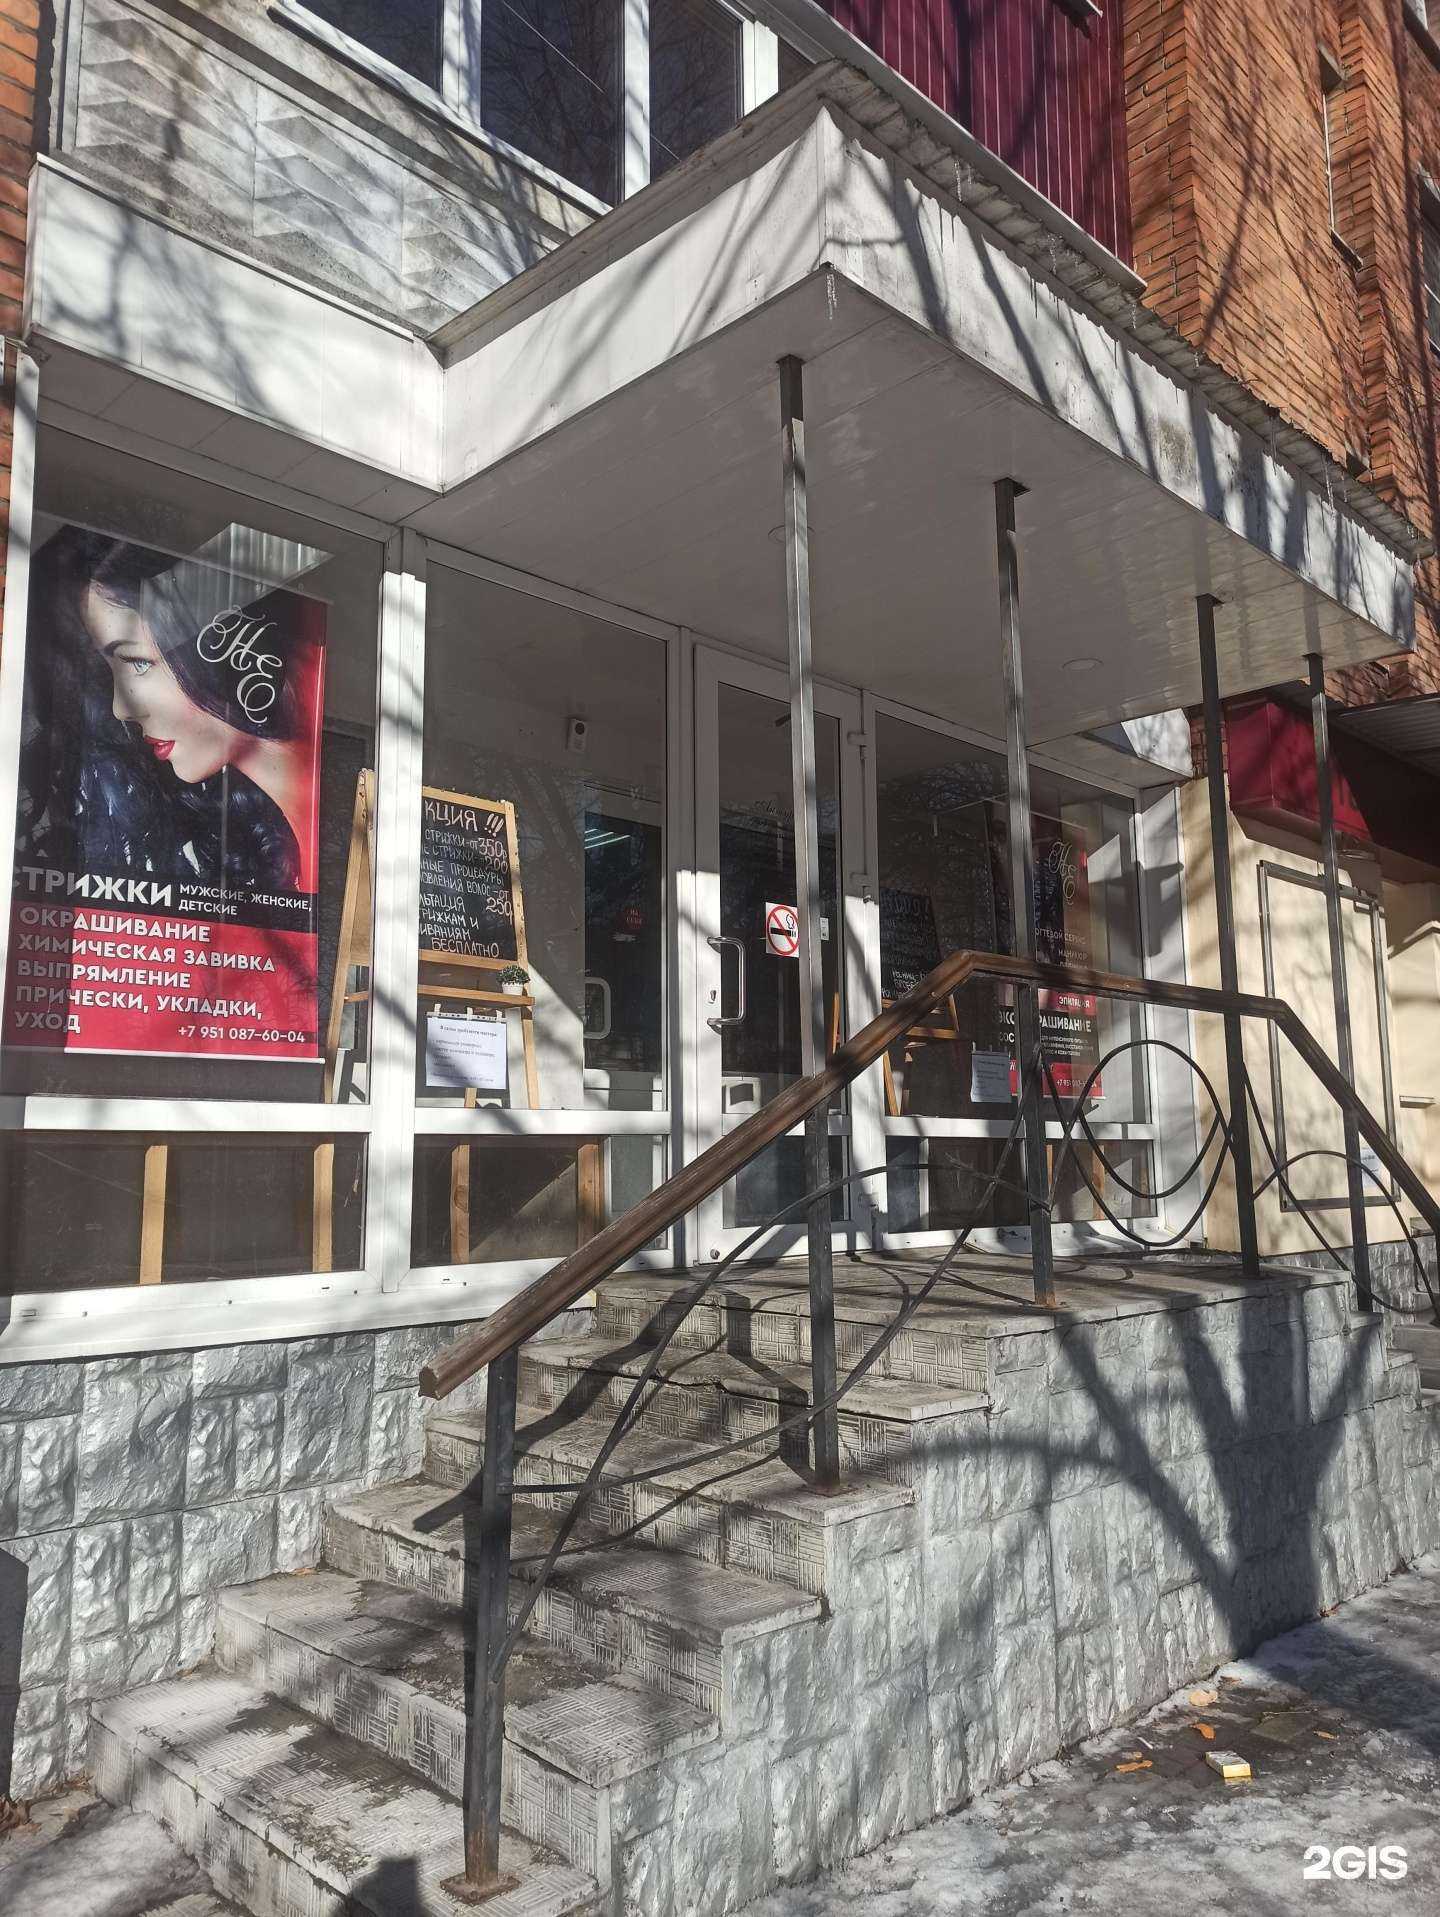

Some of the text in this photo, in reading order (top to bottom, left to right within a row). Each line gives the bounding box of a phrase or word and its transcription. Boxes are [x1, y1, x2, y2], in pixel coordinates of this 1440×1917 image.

[425, 800, 478, 832] КЦИЯ
[420, 859, 444, 873] НЫЕ
[178, 899, 238, 916] ДЕТСКИЕ
[180, 883, 247, 904] МУЖСКИЕ,
[251, 893, 312, 912] ЖЕНСКИЕ,
[420, 893, 466, 913] ЛЬТАЦИЯ
[19, 906, 211, 943] ОКРАШИВАНИЕ
[421, 908, 466, 927] РИЖКАМ
[420, 923, 471, 941] ИВАНИЯМ
[18, 934, 276, 972] ХИМИЧЕСКАЯ ЗАВИВКА
[432, 937, 500, 958] БЕСПЛАТНО
[17, 960, 191, 988] ВЫПРЯМЛЕНИЕ
[16, 985, 262, 1020] ПРИЧЕСКИ, УКЛАДКИ,
[14, 1011, 81, 1034] УХОД
[1039, 1015, 1092, 1033] РАШИВАНИЕ
[178, 1025, 305, 1043] +7 951 087-60-04
